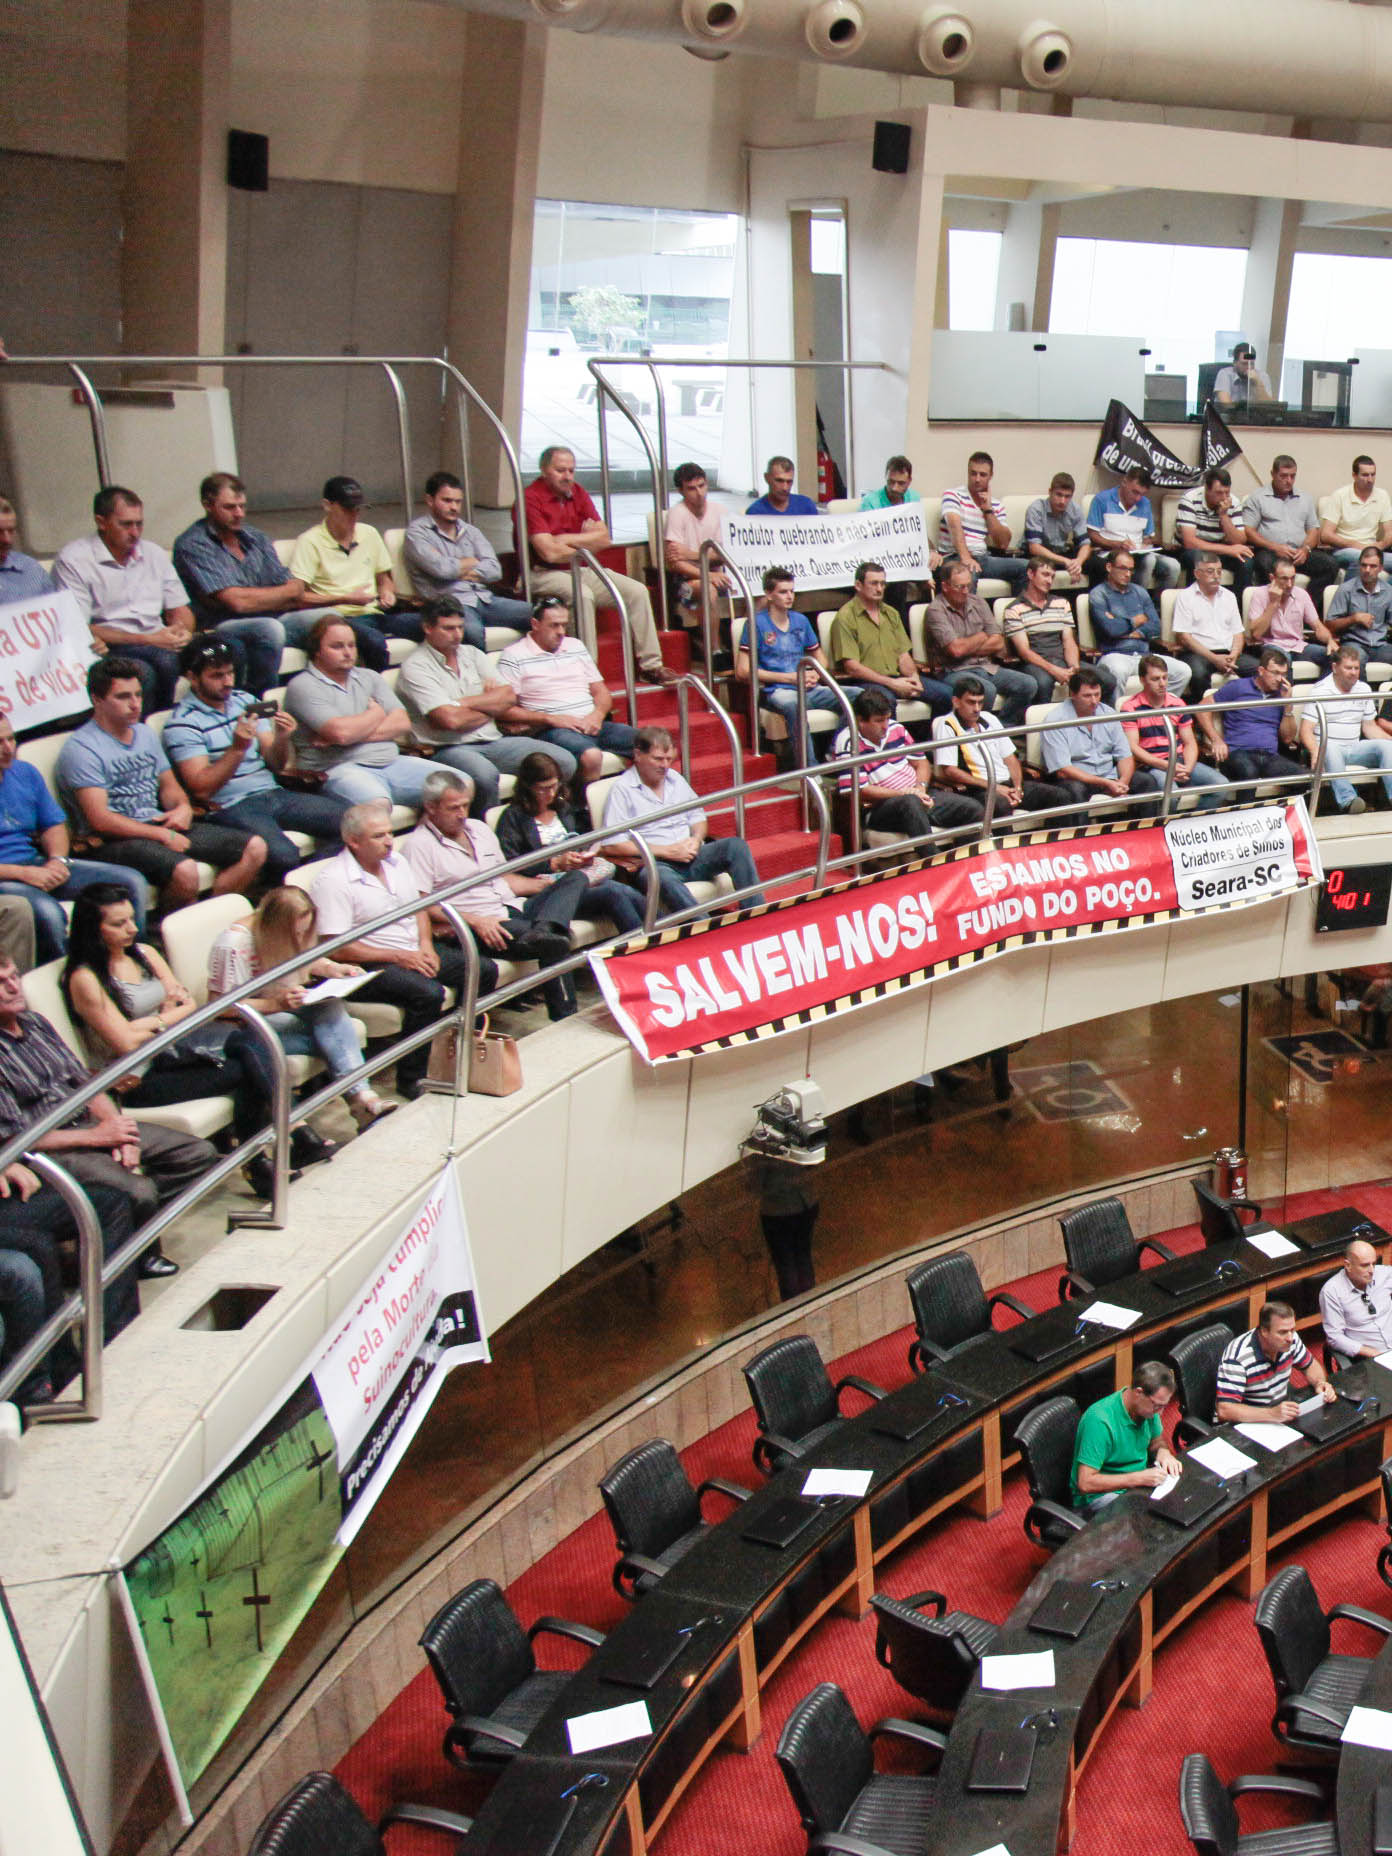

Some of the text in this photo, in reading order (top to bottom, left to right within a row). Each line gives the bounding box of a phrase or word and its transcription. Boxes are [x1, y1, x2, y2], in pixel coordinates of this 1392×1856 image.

[729, 522, 775, 547] Produtor
[779, 521, 835, 551] quebrando
[869, 520, 891, 538] tem
[893, 515, 921, 535] carne
[808, 557, 840, 578] Quem
[15, 669, 47, 706] de
[1170, 827, 1208, 848] Núcleo
[1210, 819, 1263, 842] Municipal
[969, 847, 1130, 897] ESTAMOS NO
[1181, 847, 1235, 868] Criadores
[1236, 842, 1250, 859] de
[1191, 863, 1282, 900] Seara-SC
[957, 877, 1161, 940] FUNDO DO POÇO.
[644, 891, 938, 1028] SALVEM-NOS!
[347, 1328, 384, 1385] pela
